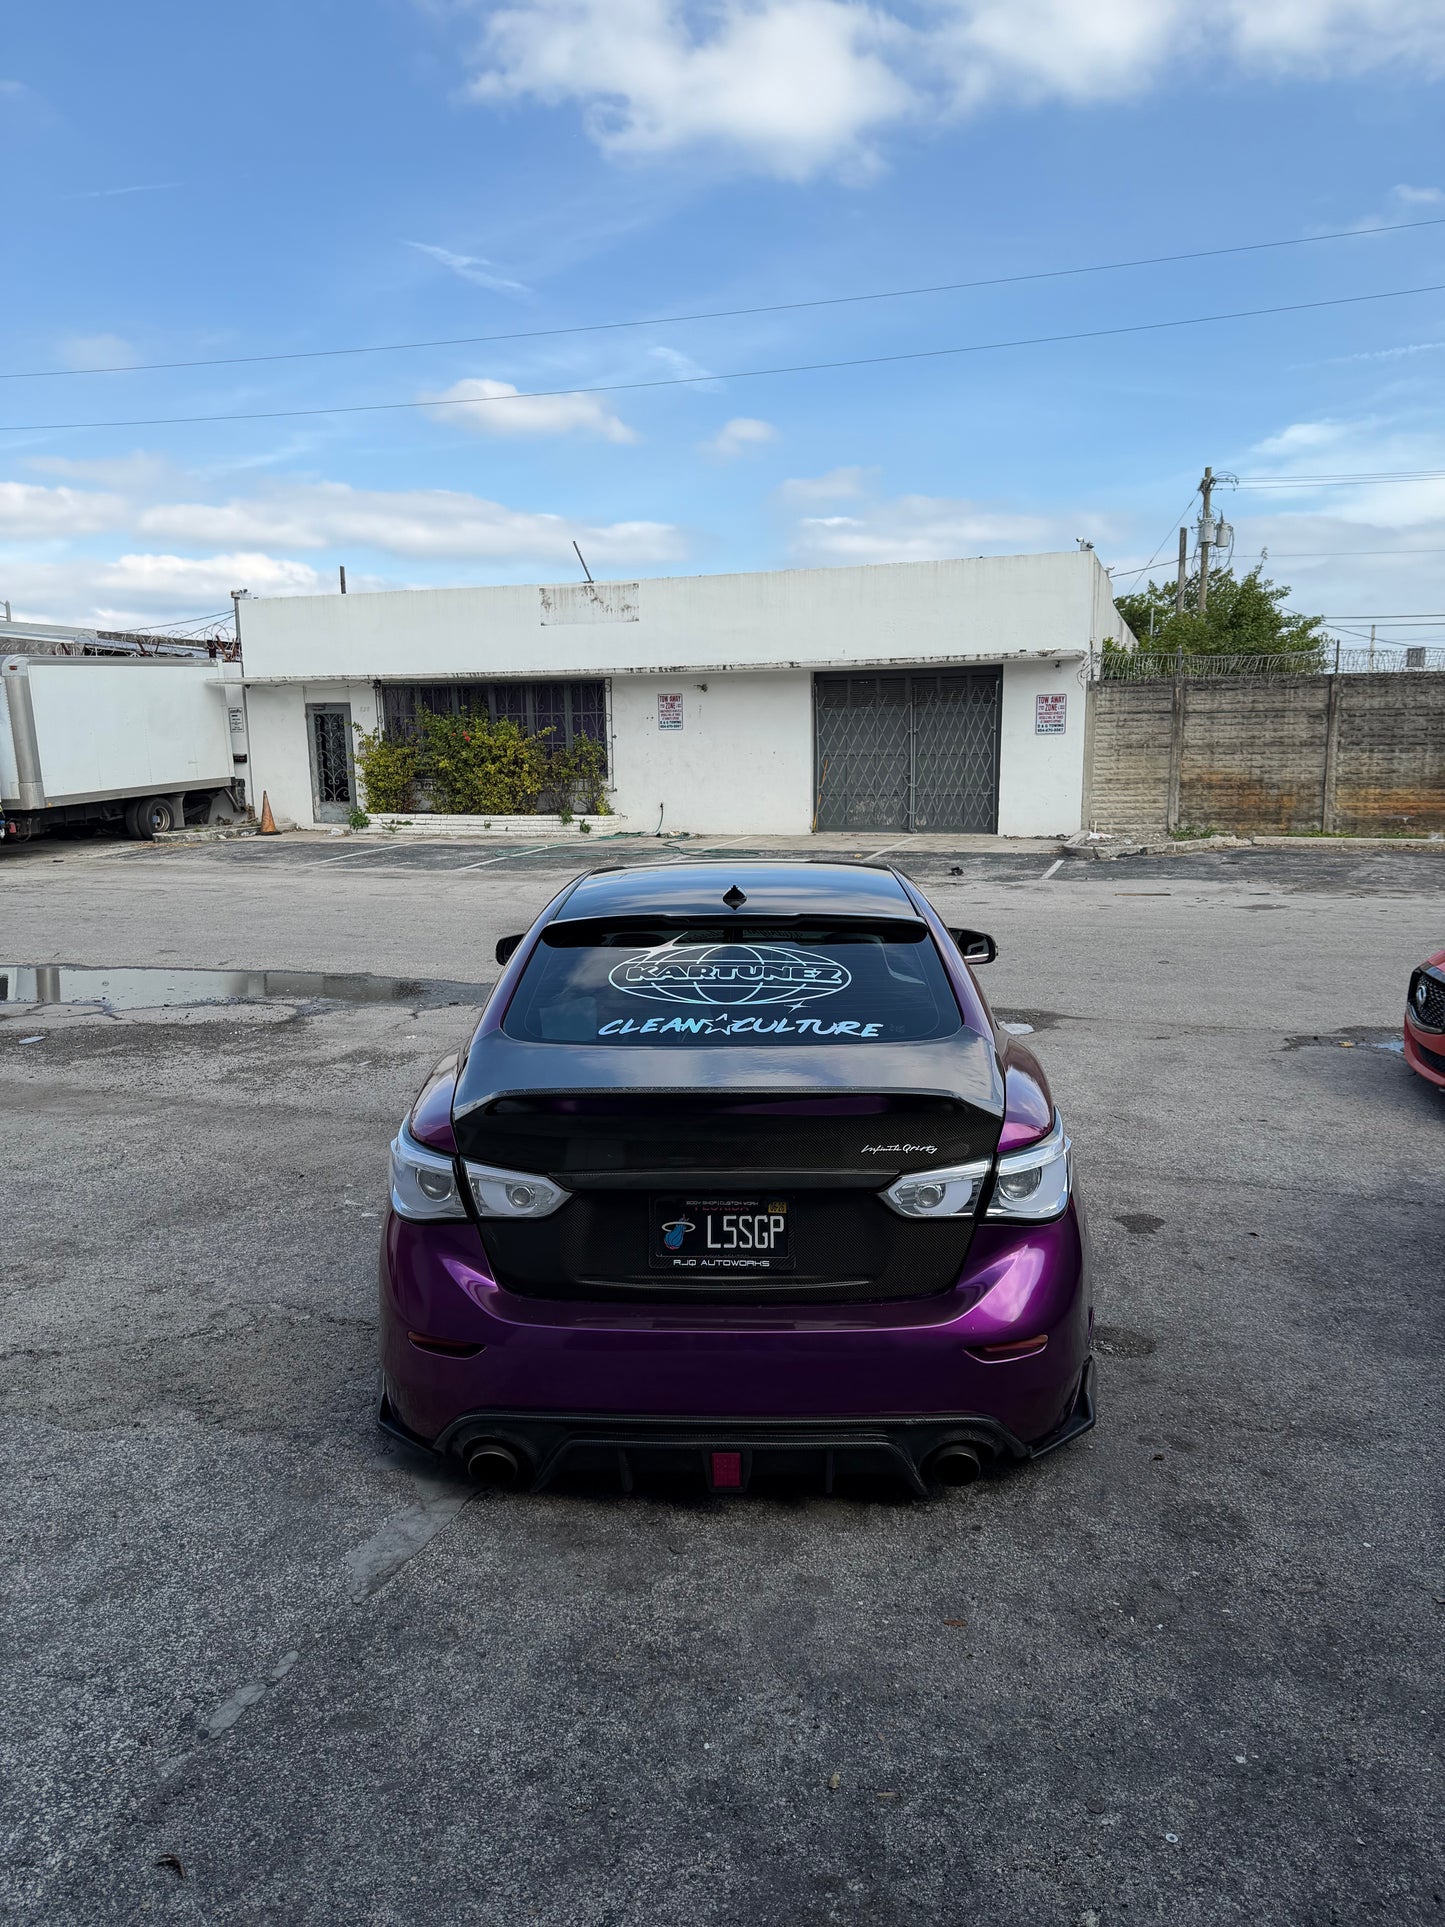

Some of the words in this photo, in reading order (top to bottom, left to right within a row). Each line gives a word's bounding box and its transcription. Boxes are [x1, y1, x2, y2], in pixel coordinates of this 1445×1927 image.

[625, 964, 843, 984] KARTUNEZ
[598, 1015, 706, 1036] CLEAN
[731, 1017, 884, 1038] CULTURE
[707, 1215, 785, 1249] L5SGP
[700, 1259, 770, 1267] AUTOWORKS
